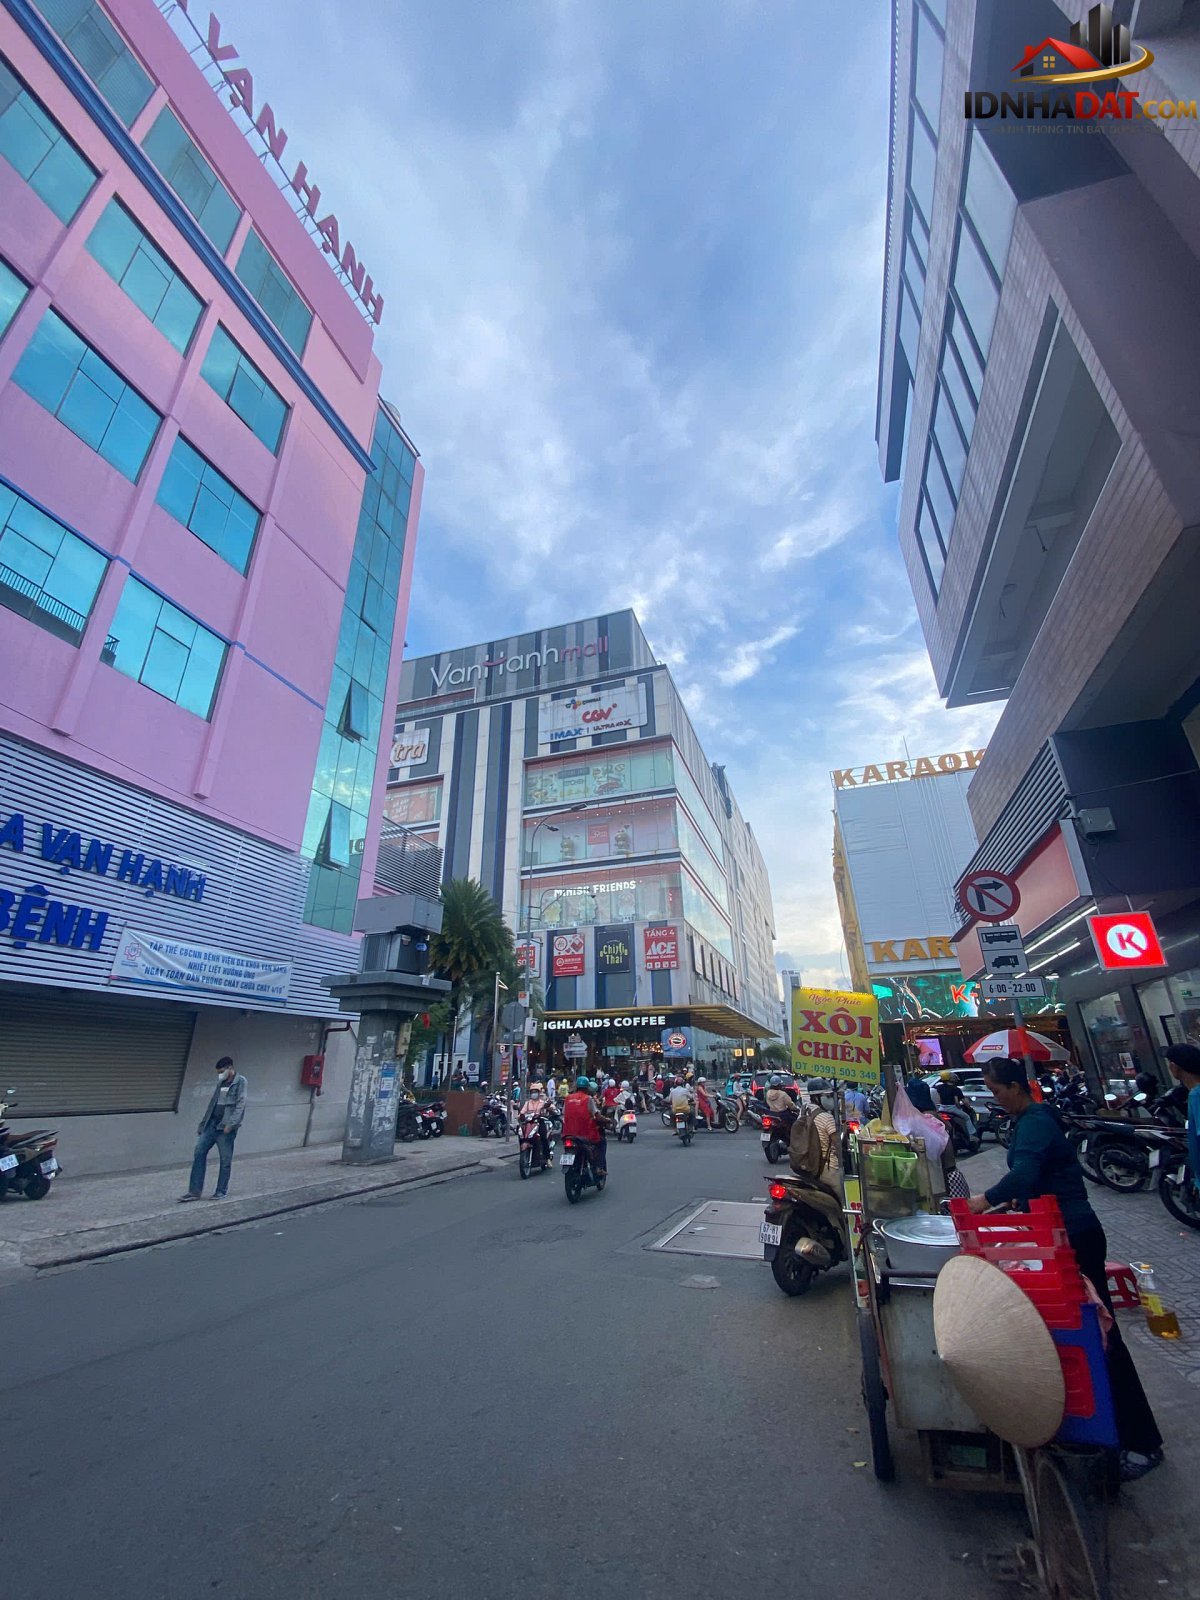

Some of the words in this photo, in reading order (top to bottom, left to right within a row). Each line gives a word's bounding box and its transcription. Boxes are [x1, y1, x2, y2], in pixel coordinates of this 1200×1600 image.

[207, 12, 288, 161] VẠN
[292, 160, 385, 325] HẠNH
[41, 823, 114, 876] VẠN
[116, 849, 207, 903] HẠNH
[593, 880, 636, 894] FRIENDS
[669, 928, 675, 936] 4
[646, 940, 676, 956] ACE
[541, 1017, 611, 1031] IGHLANDS
[613, 1015, 666, 1027] COFFEE
[799, 1006, 873, 1039] XÔI
[797, 1040, 873, 1065] CHIÊN
[839, 1067, 857, 1077] 503
